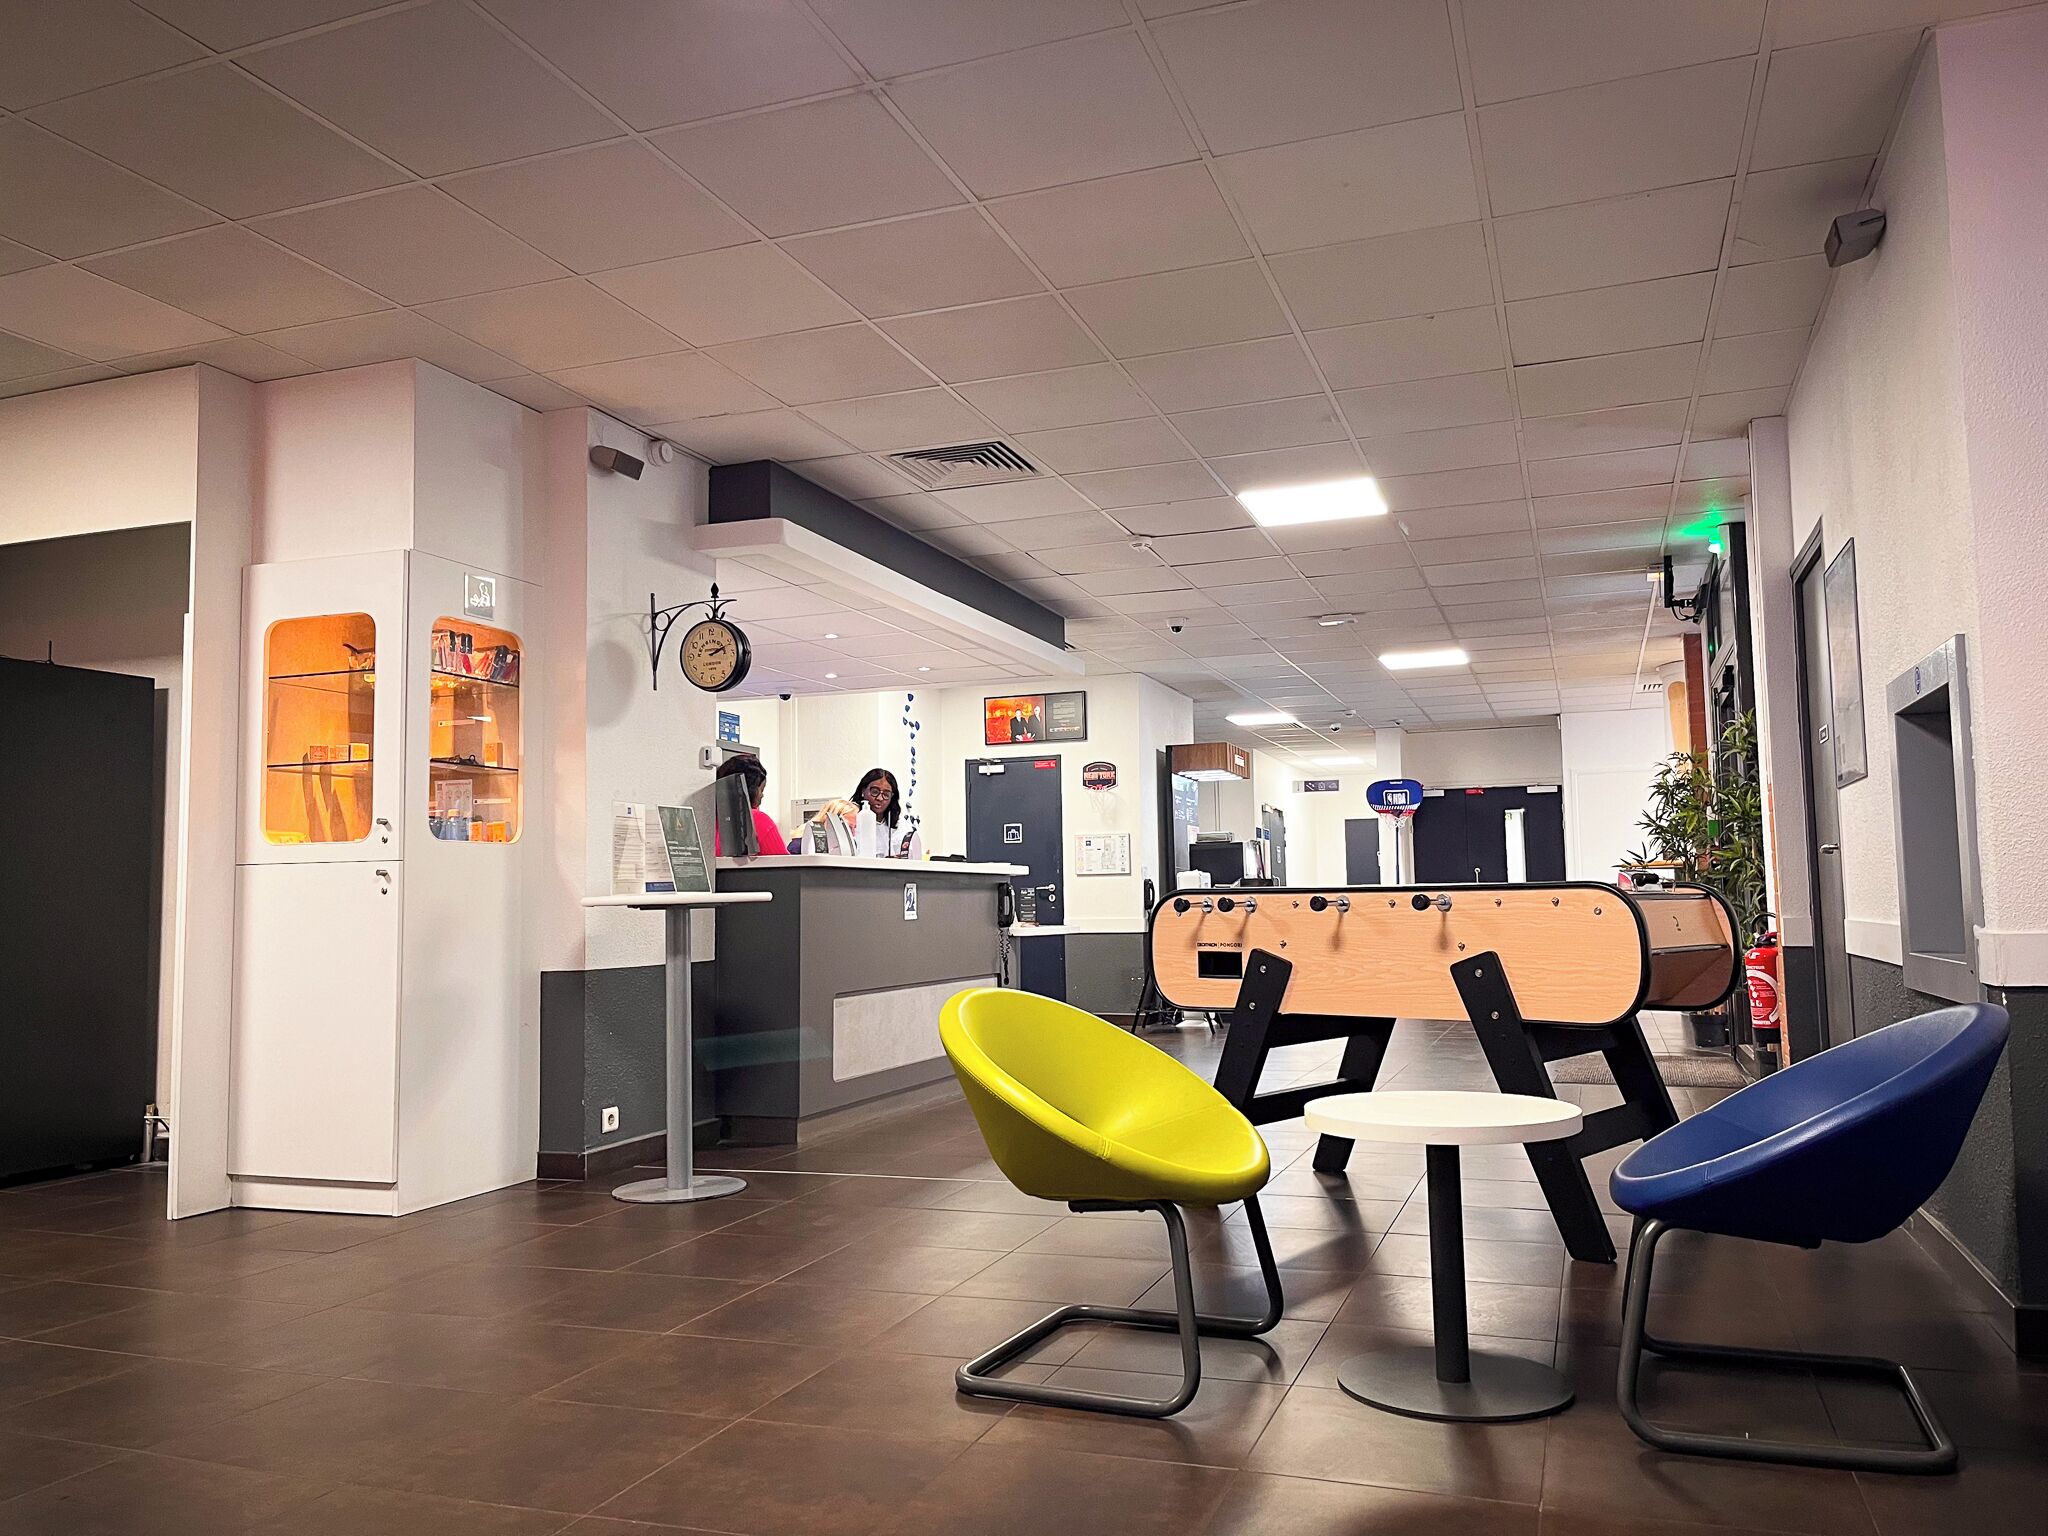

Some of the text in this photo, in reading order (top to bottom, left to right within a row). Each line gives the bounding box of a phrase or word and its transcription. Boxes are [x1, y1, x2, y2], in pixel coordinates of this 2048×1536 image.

[697, 640, 726, 658] KENSINGTN
[1084, 771, 1116, 780] NEW YORK
[1392, 792, 1406, 805] NBA
